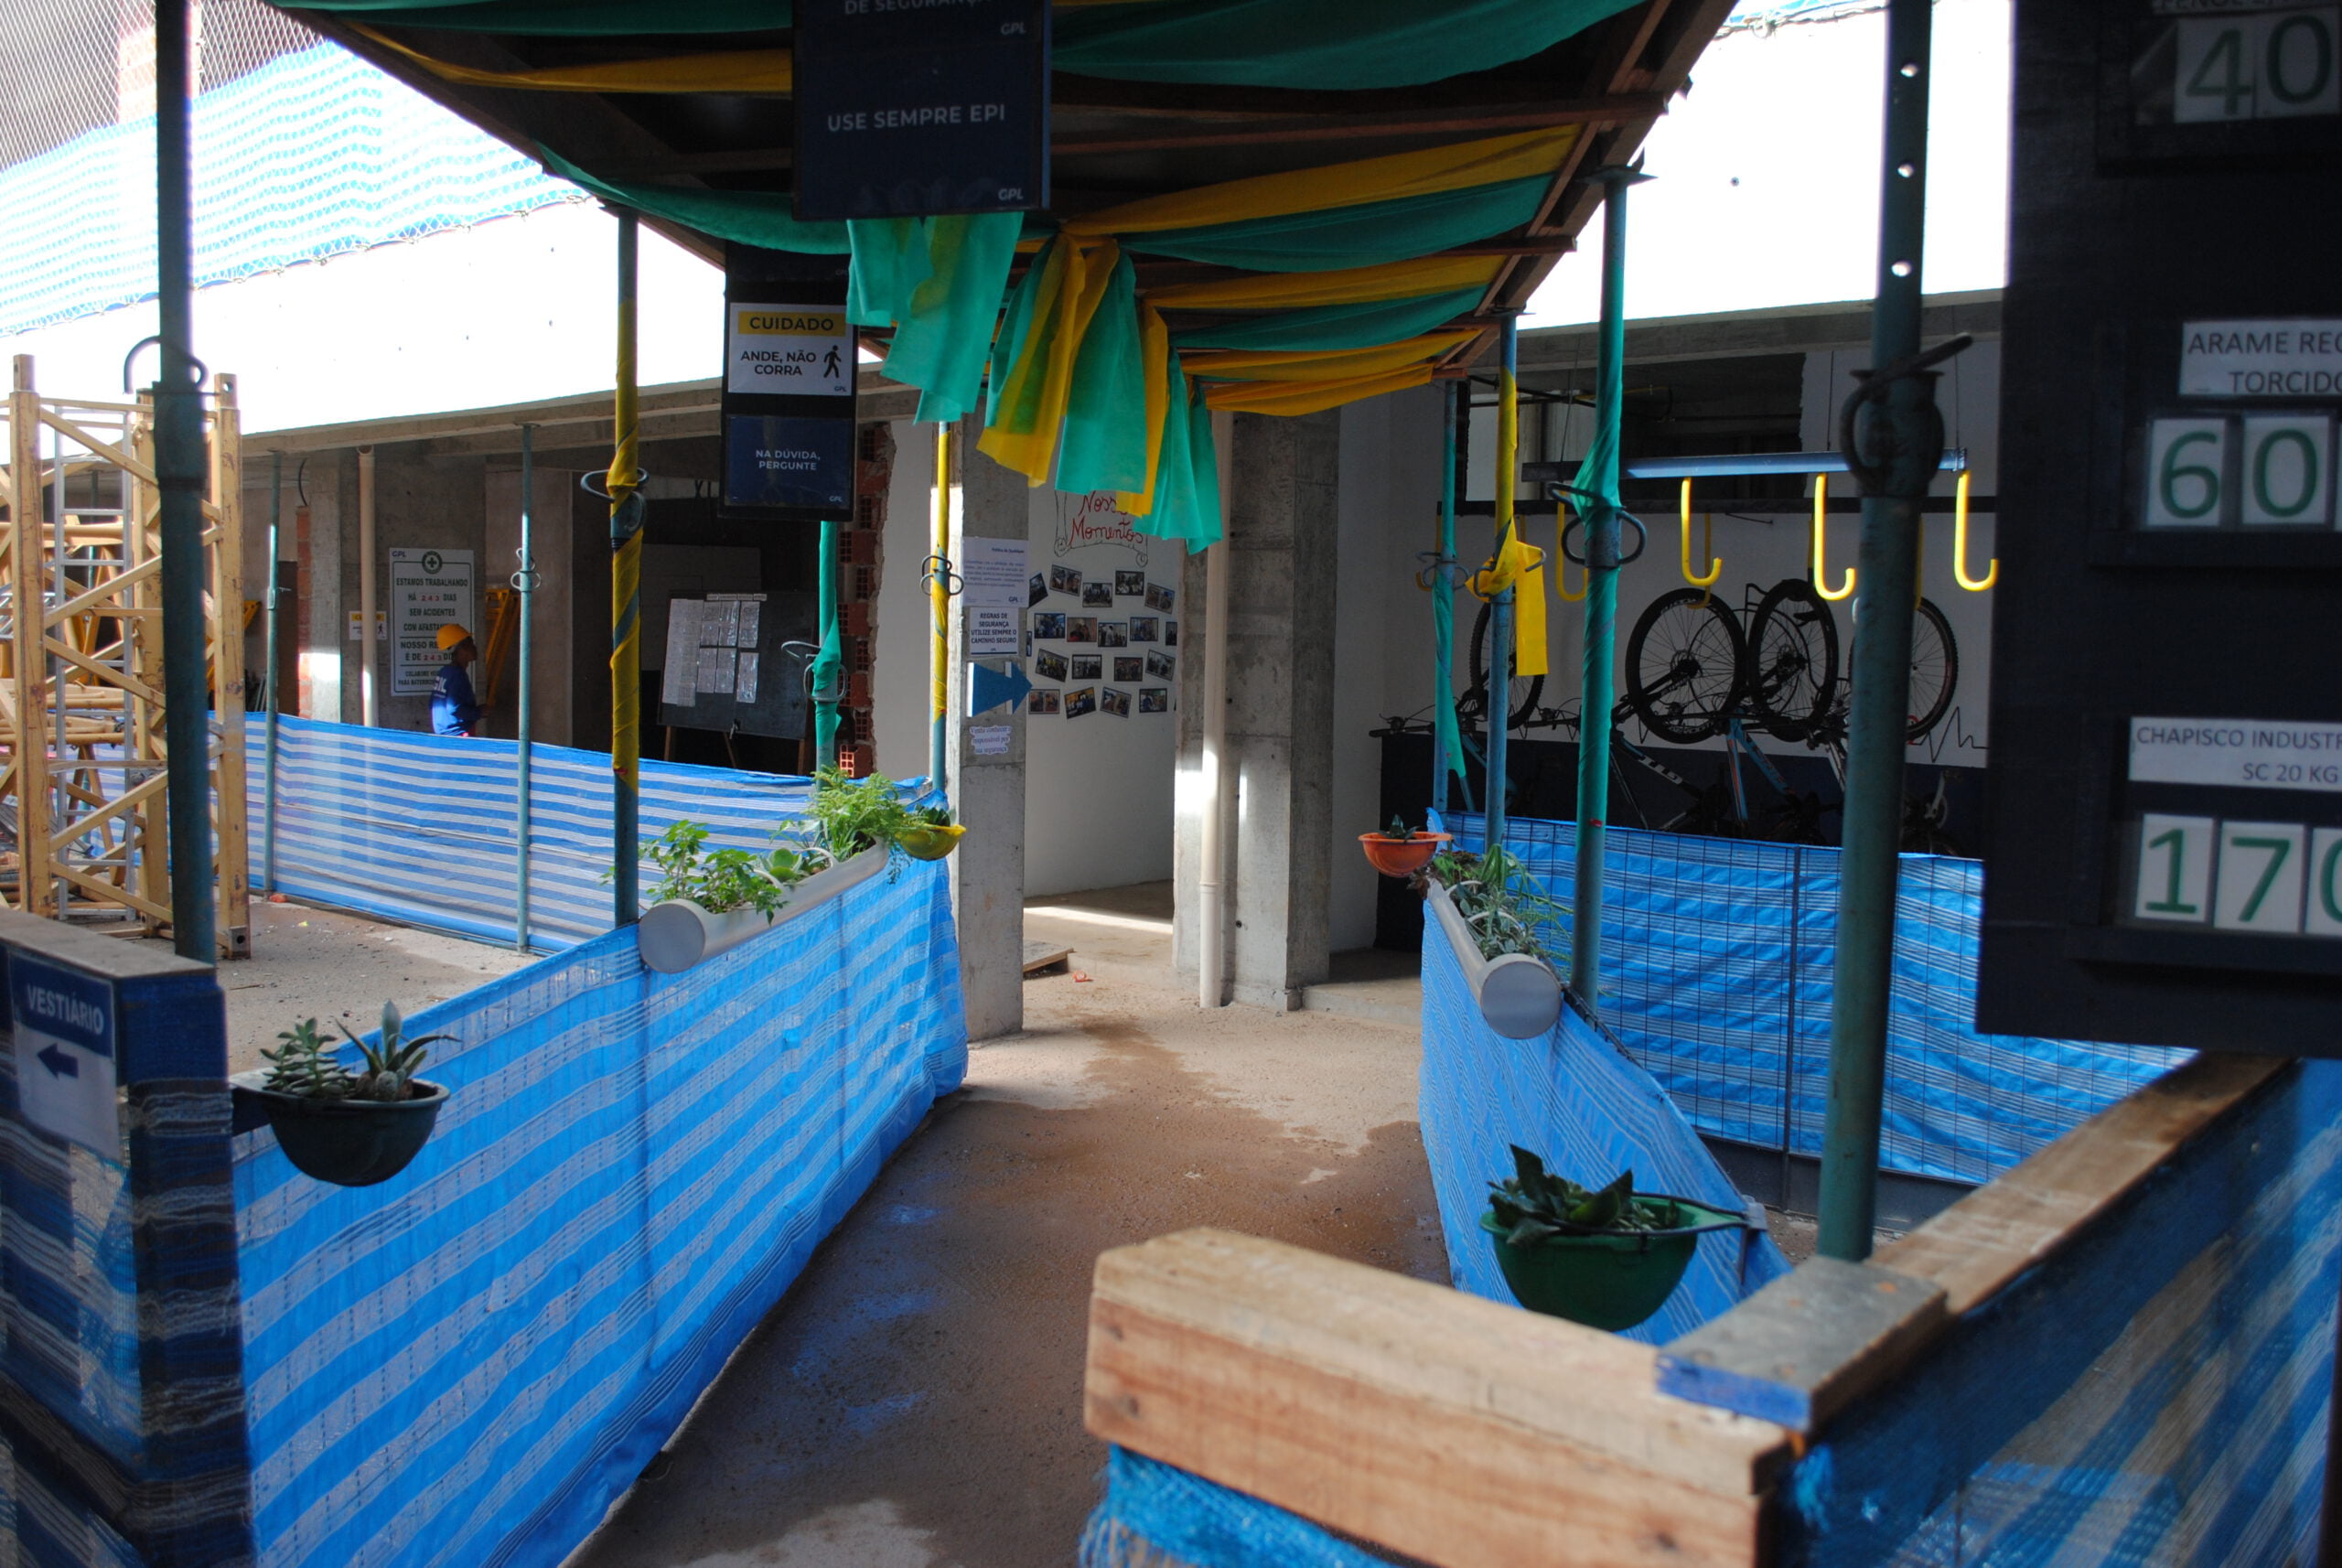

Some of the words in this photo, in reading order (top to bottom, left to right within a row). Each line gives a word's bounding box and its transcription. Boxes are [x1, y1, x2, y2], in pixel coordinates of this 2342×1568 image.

[845, 0, 868, 15] DE
[875, 0, 990, 12] SEGUR
[1001, 22, 1026, 35] GPL
[2186, 15, 2333, 116] 40
[827, 113, 867, 132] USE
[874, 106, 962, 129] SEMPRE
[970, 104, 1005, 123] EPI
[998, 188, 1024, 200] GPL
[749, 317, 834, 331] CUIDADO
[2187, 331, 2290, 355] ARAME
[740, 350, 783, 363] ANDE,
[786, 349, 817, 362] NÃO
[754, 364, 803, 376] CORRA
[755, 449, 771, 458] NA
[774, 447, 822, 461] DÚVIDA,
[758, 460, 818, 471] PERGUNTE
[1078, 490, 1127, 516] Noss
[1068, 515, 1144, 547] Momentos
[424, 578, 468, 587] TRABALHANDO
[410, 608, 422, 617] SEM
[423, 608, 456, 617] ACIDENTES
[418, 623, 443, 631] AFASTA
[412, 652, 422, 660] DE
[2135, 725, 2245, 747] CHAPISCO
[2242, 762, 2269, 781] SC
[2275, 765, 2302, 782] 20
[2309, 765, 2339, 784] KG
[27, 983, 105, 1036] VESTIÁRIO
